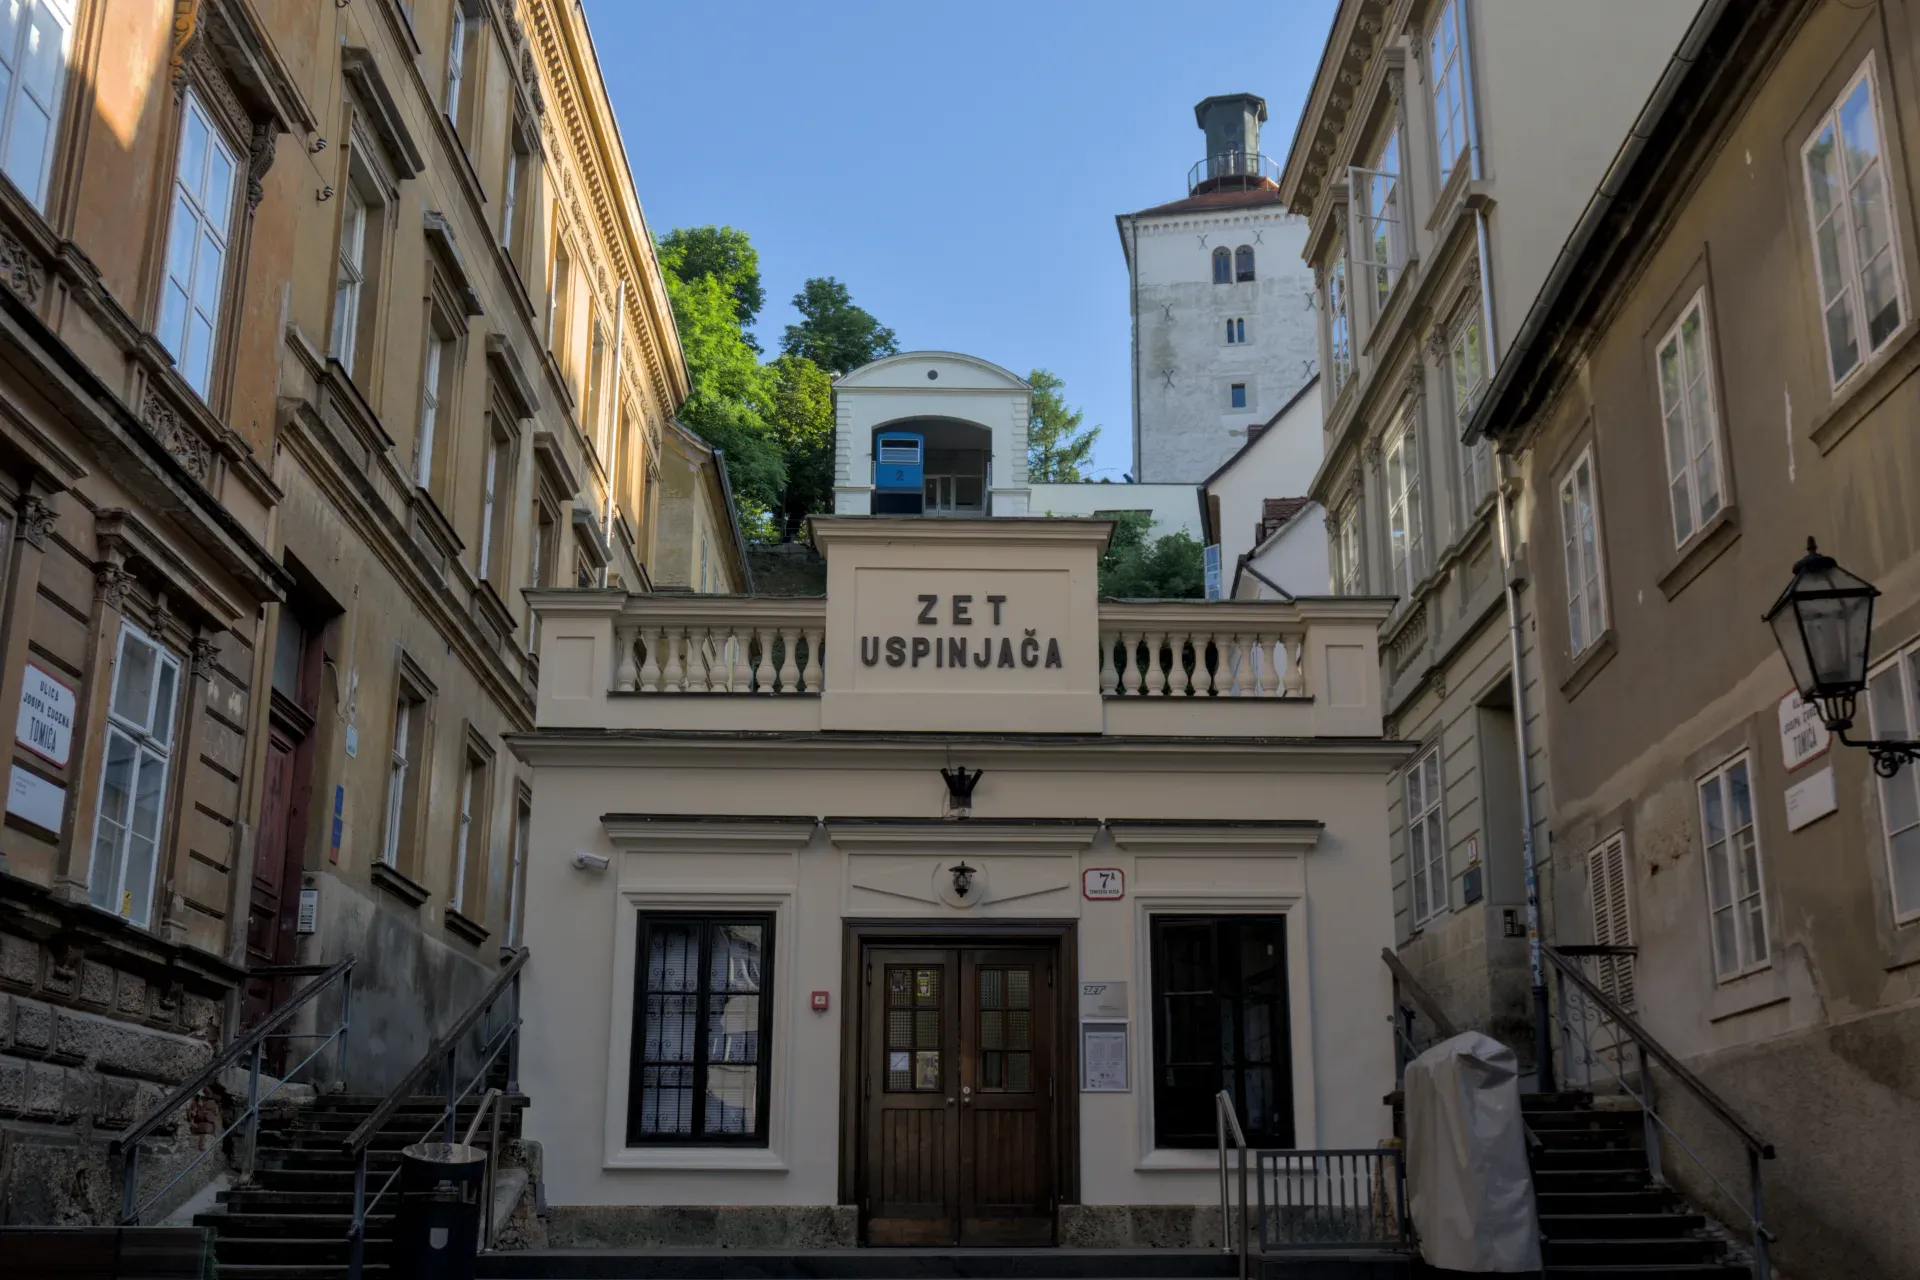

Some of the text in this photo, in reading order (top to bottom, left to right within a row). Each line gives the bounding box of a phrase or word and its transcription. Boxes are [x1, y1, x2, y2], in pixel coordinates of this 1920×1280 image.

[895, 469, 904, 481] 2
[917, 594, 1007, 625] ZET
[861, 628, 1063, 669] USPINJAČA
[40, 680, 59, 702] ULICA
[23, 692, 71, 728] JOSIPA EUGENA
[29, 716, 57, 754] TOMIĆA
[1084, 985, 1107, 996] ZET
